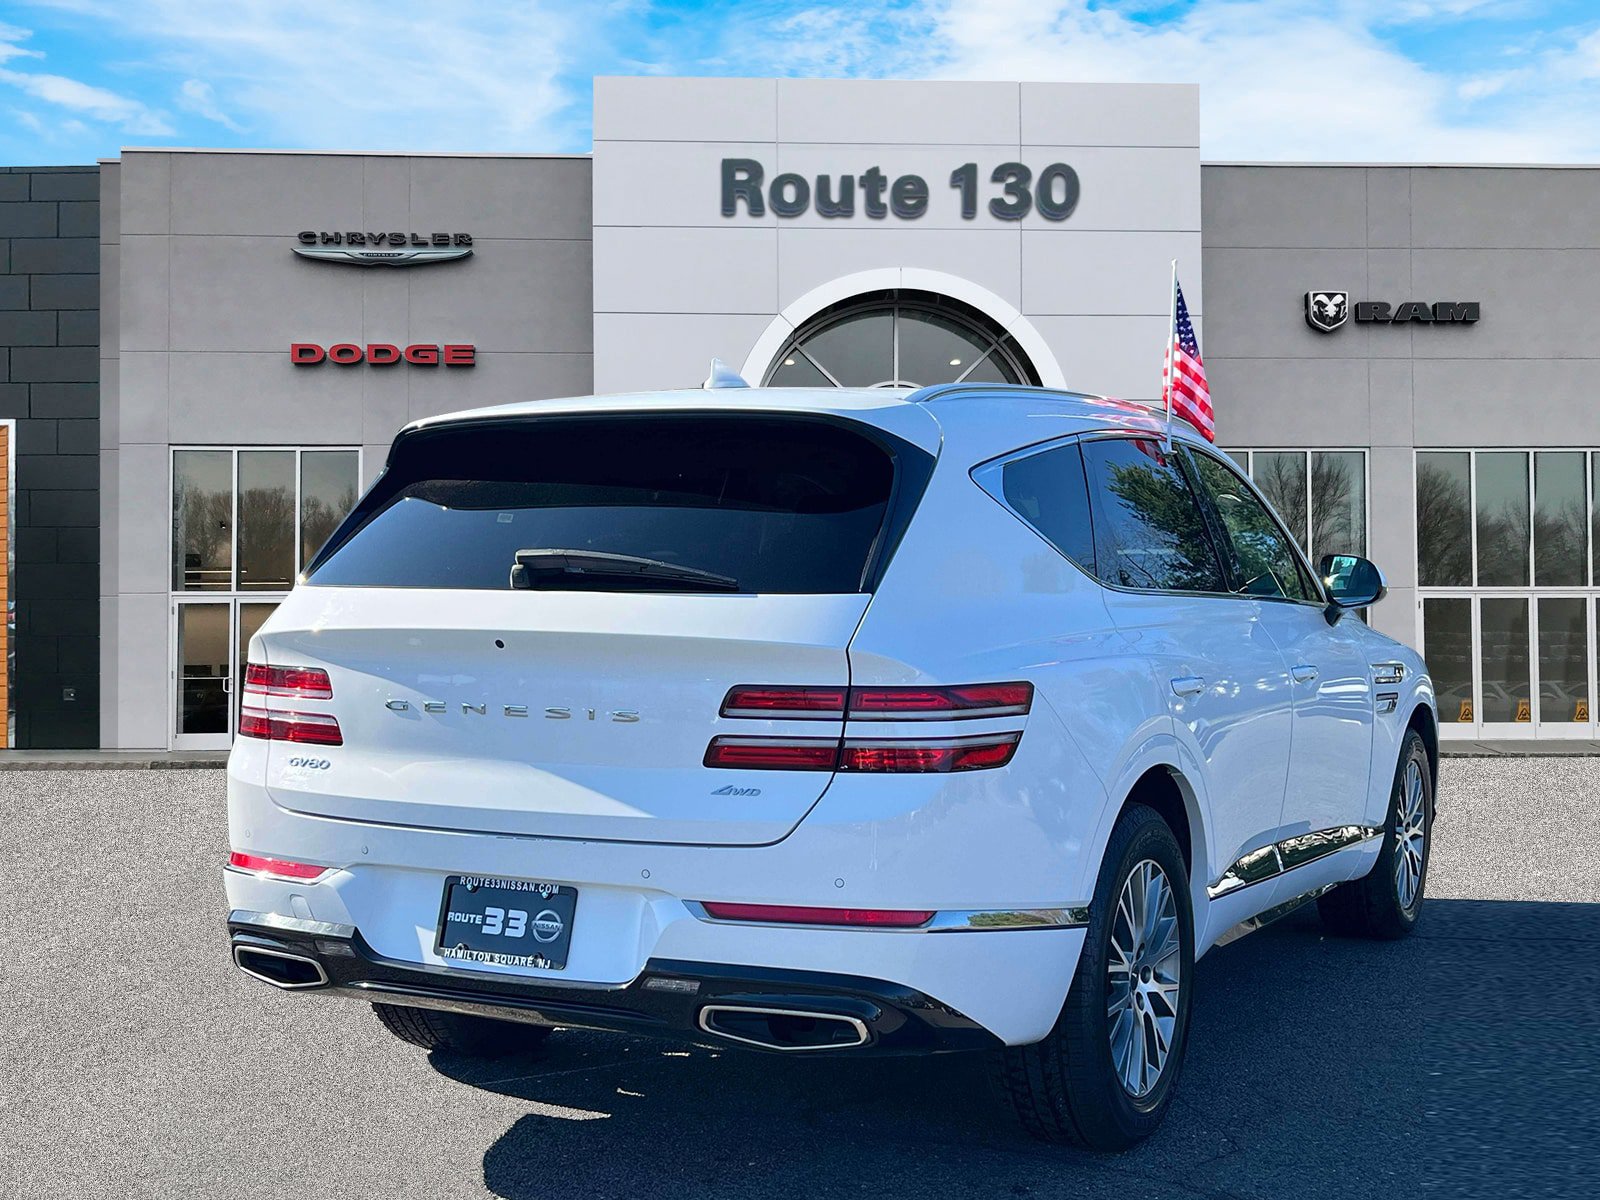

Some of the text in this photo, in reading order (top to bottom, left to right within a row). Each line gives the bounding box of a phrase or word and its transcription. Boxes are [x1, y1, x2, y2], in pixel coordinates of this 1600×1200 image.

[720, 158, 1080, 221] Route 130
[298, 231, 473, 246] CHRYSLER
[1355, 302, 1480, 324] RAM
[291, 343, 476, 366] DODGE
[385, 700, 640, 723] GENESIS
[289, 757, 331, 770] GV80
[710, 784, 762, 797] 4WD
[460, 876, 560, 894] ROUTE33NISSAN.COM
[447, 906, 529, 938] ROUTE 33
[533, 921, 560, 932] NISSAN
[444, 948, 491, 963] HAMILTON
[538, 958, 551, 969] NJ
